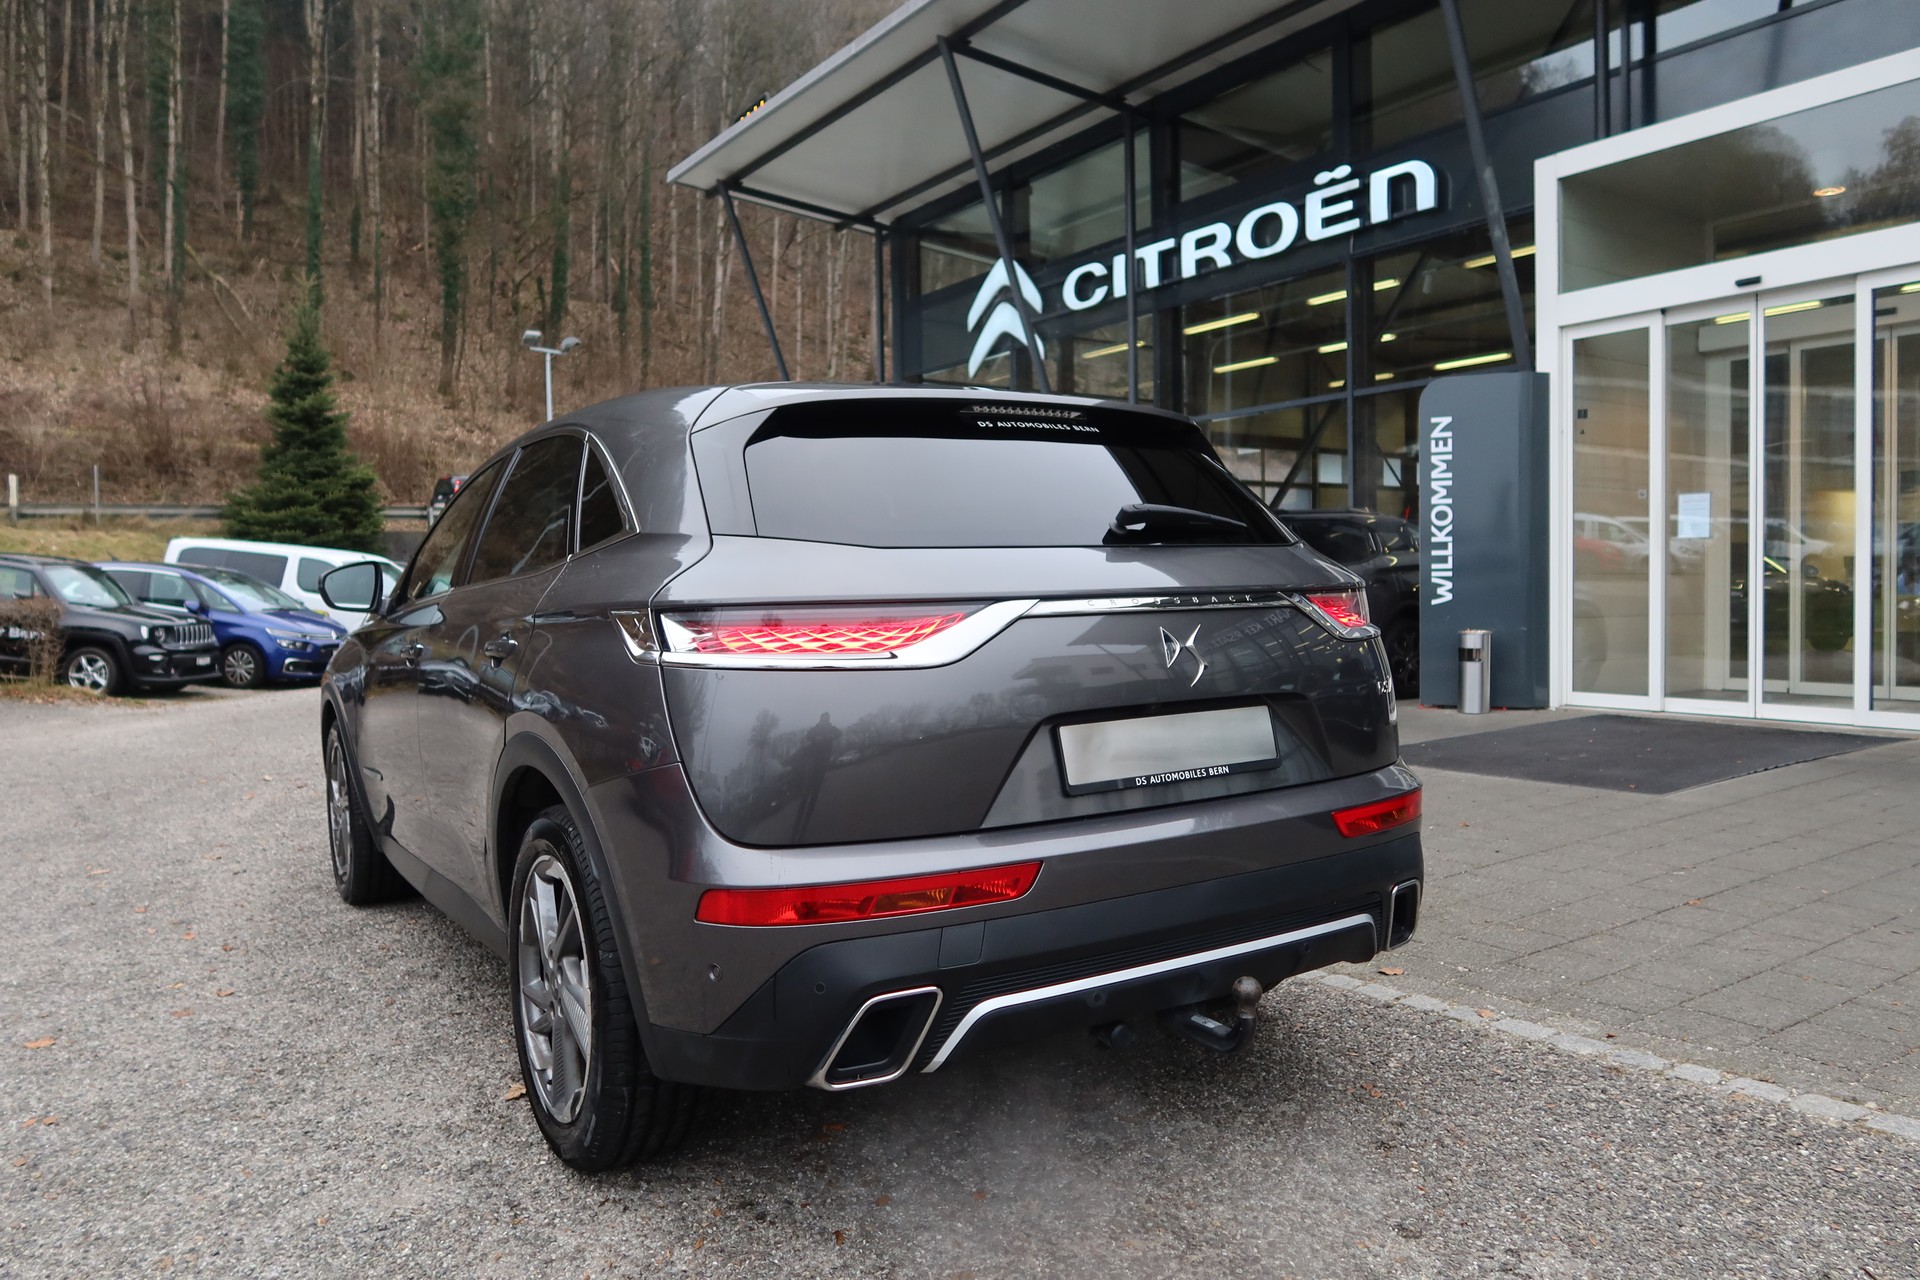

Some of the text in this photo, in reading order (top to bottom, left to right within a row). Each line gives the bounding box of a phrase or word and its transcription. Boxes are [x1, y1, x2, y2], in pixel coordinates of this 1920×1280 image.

[977, 420, 1100, 433] DS AUTOMOBILES BERN
[1430, 416, 1454, 605] WILLKOMMEN
[1086, 594, 1253, 608] CROSSBACK
[1135, 765, 1230, 786] DS AUTOMOBILES BERN
